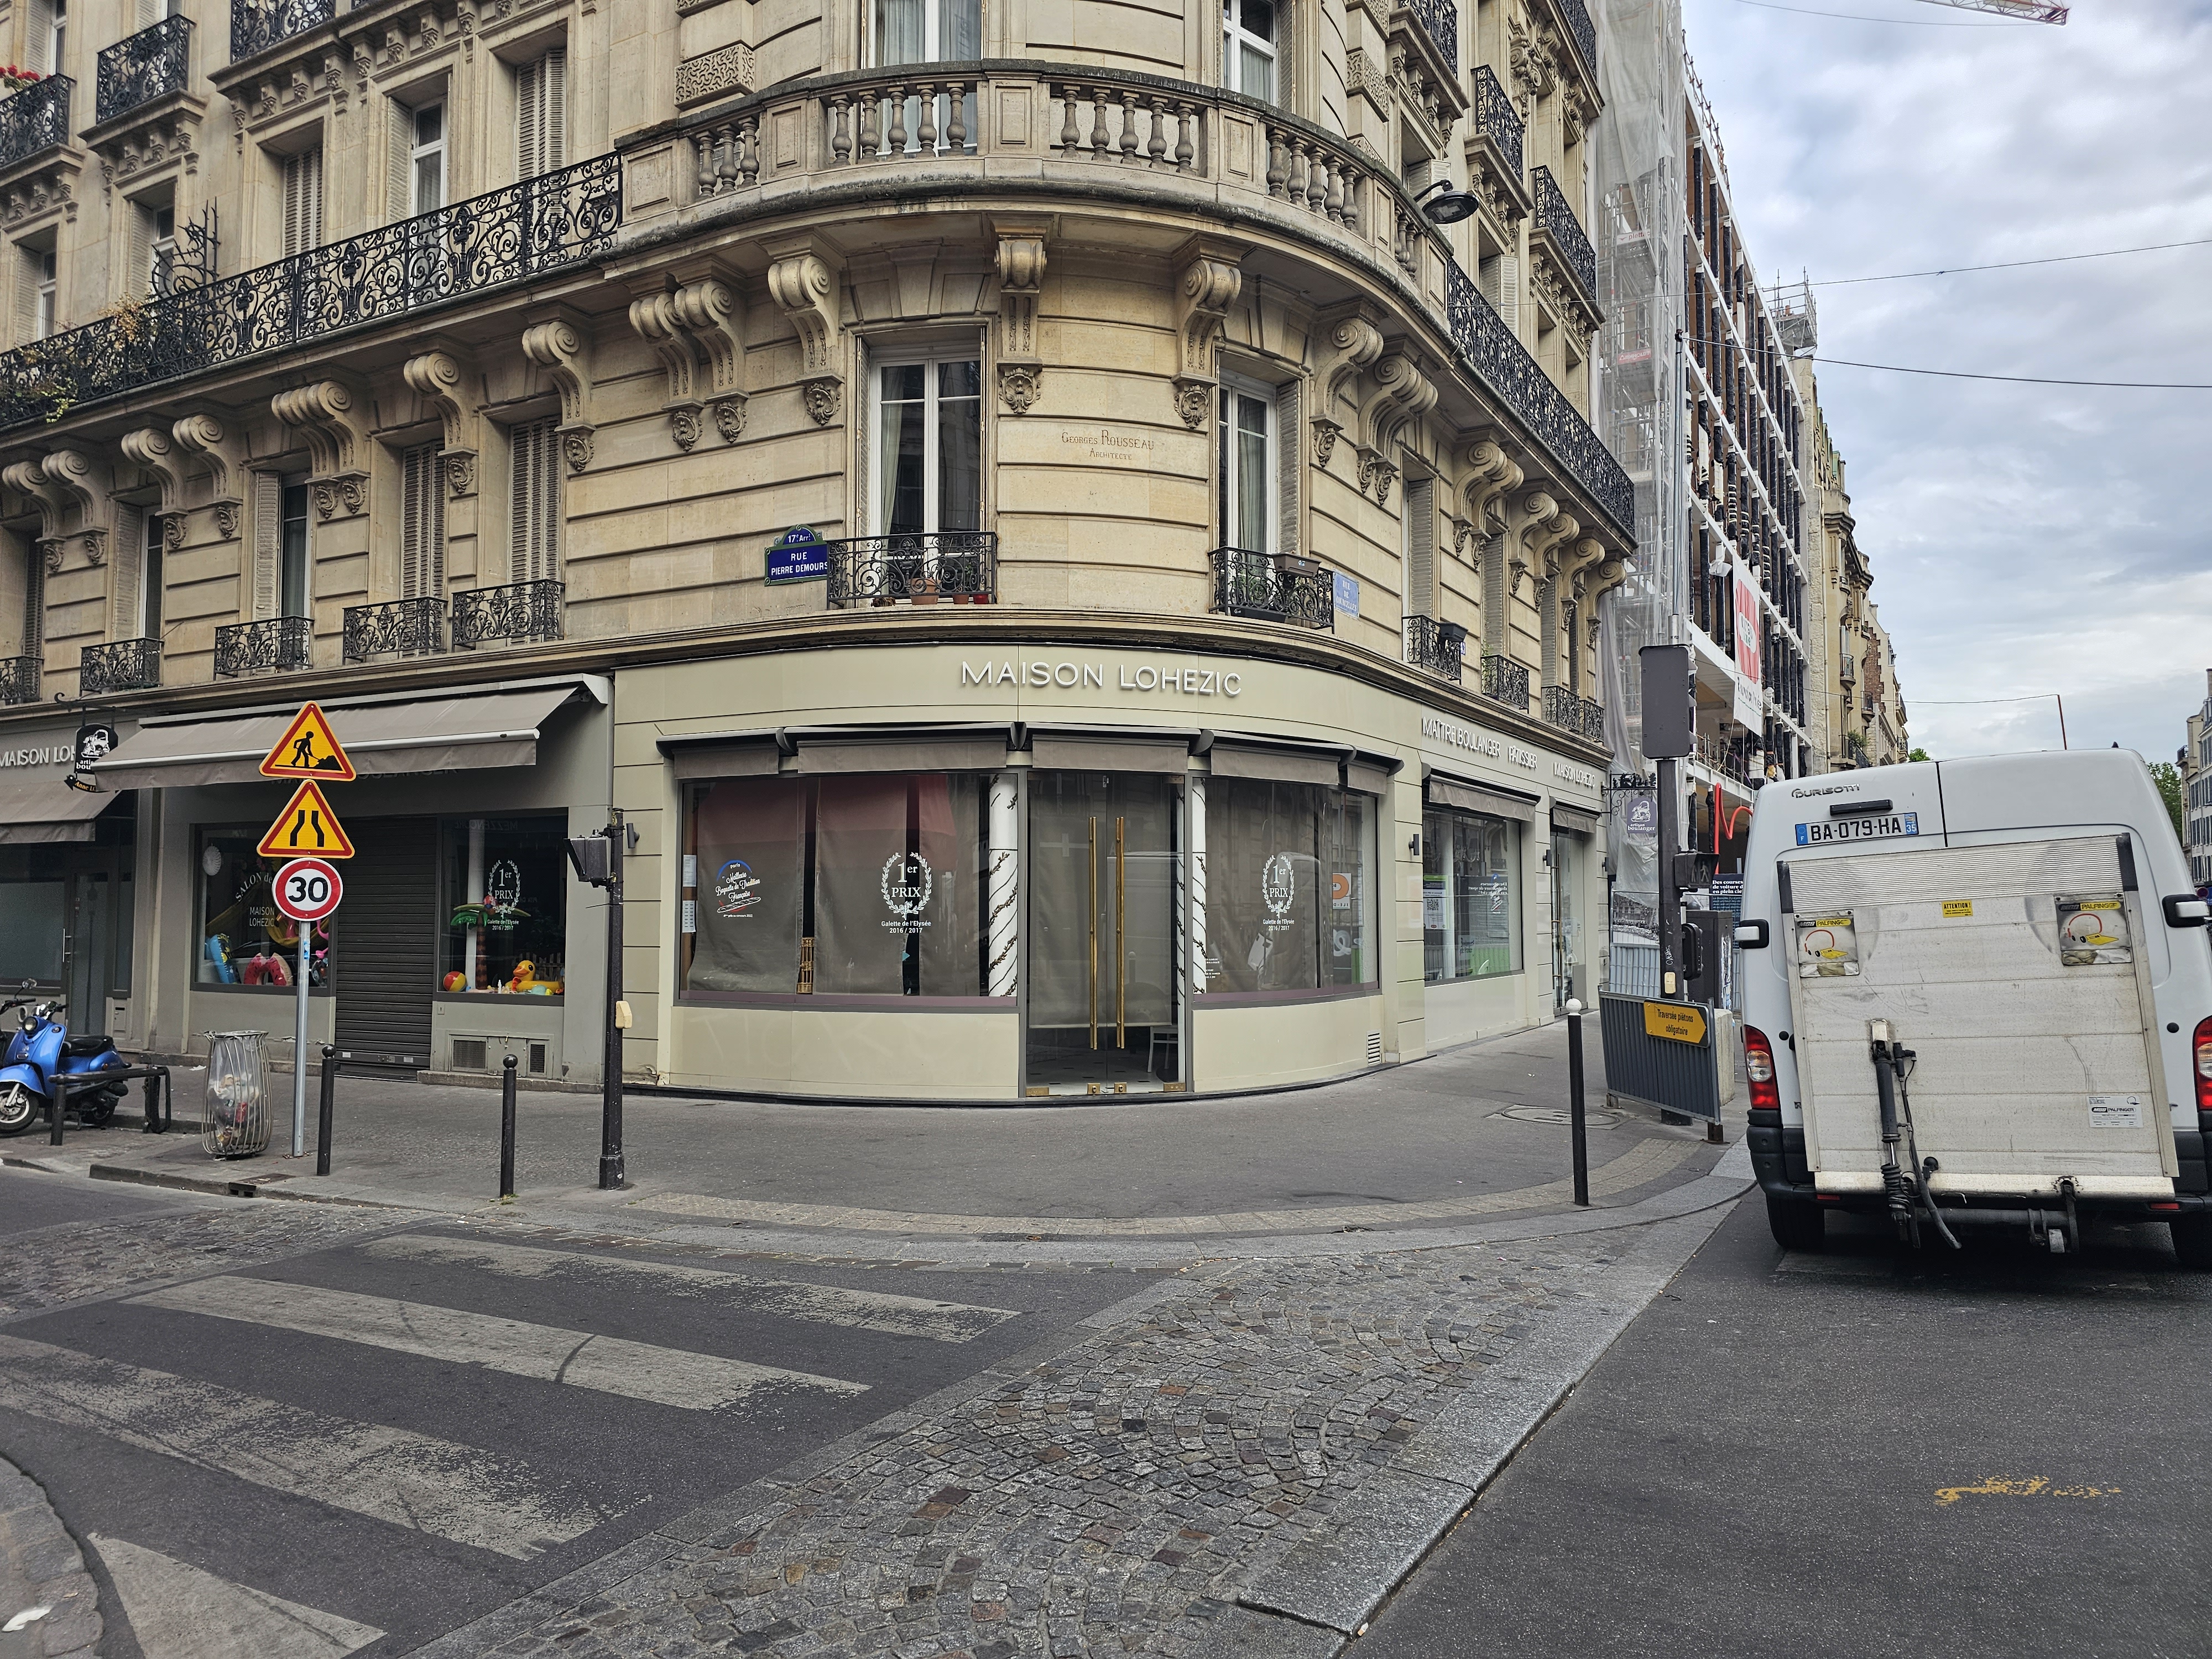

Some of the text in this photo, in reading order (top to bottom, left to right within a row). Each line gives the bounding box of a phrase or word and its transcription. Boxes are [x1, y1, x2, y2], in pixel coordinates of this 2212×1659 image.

[1102, 429, 1154, 450] ROUSSEAU
[791, 552, 807, 561] RUE
[771, 561, 828, 576] PIERRE DEMOURS
[1342, 580, 1350, 591] RUE
[1344, 590, 1349, 598] DE
[962, 661, 1241, 696] MAISON LOHEZIC
[0, 747, 49, 767] MAISON
[1422, 716, 1596, 788] MAÎTRE BOULANGER PÂTISSIER MAISON LOHEZIC
[75, 781, 89, 791] Anne
[1792, 783, 1860, 799] DURISOTTI
[1810, 817, 1902, 841] BA-079-HA
[1906, 823, 1917, 833] 35
[498, 868, 512, 886] 1er
[898, 862, 918, 883] 1er
[1273, 864, 1286, 884] 1er
[235, 872, 273, 902] SALON de
[288, 877, 328, 902] 30
[494, 890, 514, 899] PRIX
[891, 887, 921, 898] PRIX
[1269, 888, 1288, 898] PRIX
[249, 906, 274, 915] MAISON
[249, 917, 274, 927] LOHEZIC
[1657, 1009, 1693, 1022] Traversée piétons
[1666, 1024, 1688, 1036] obligatoire
